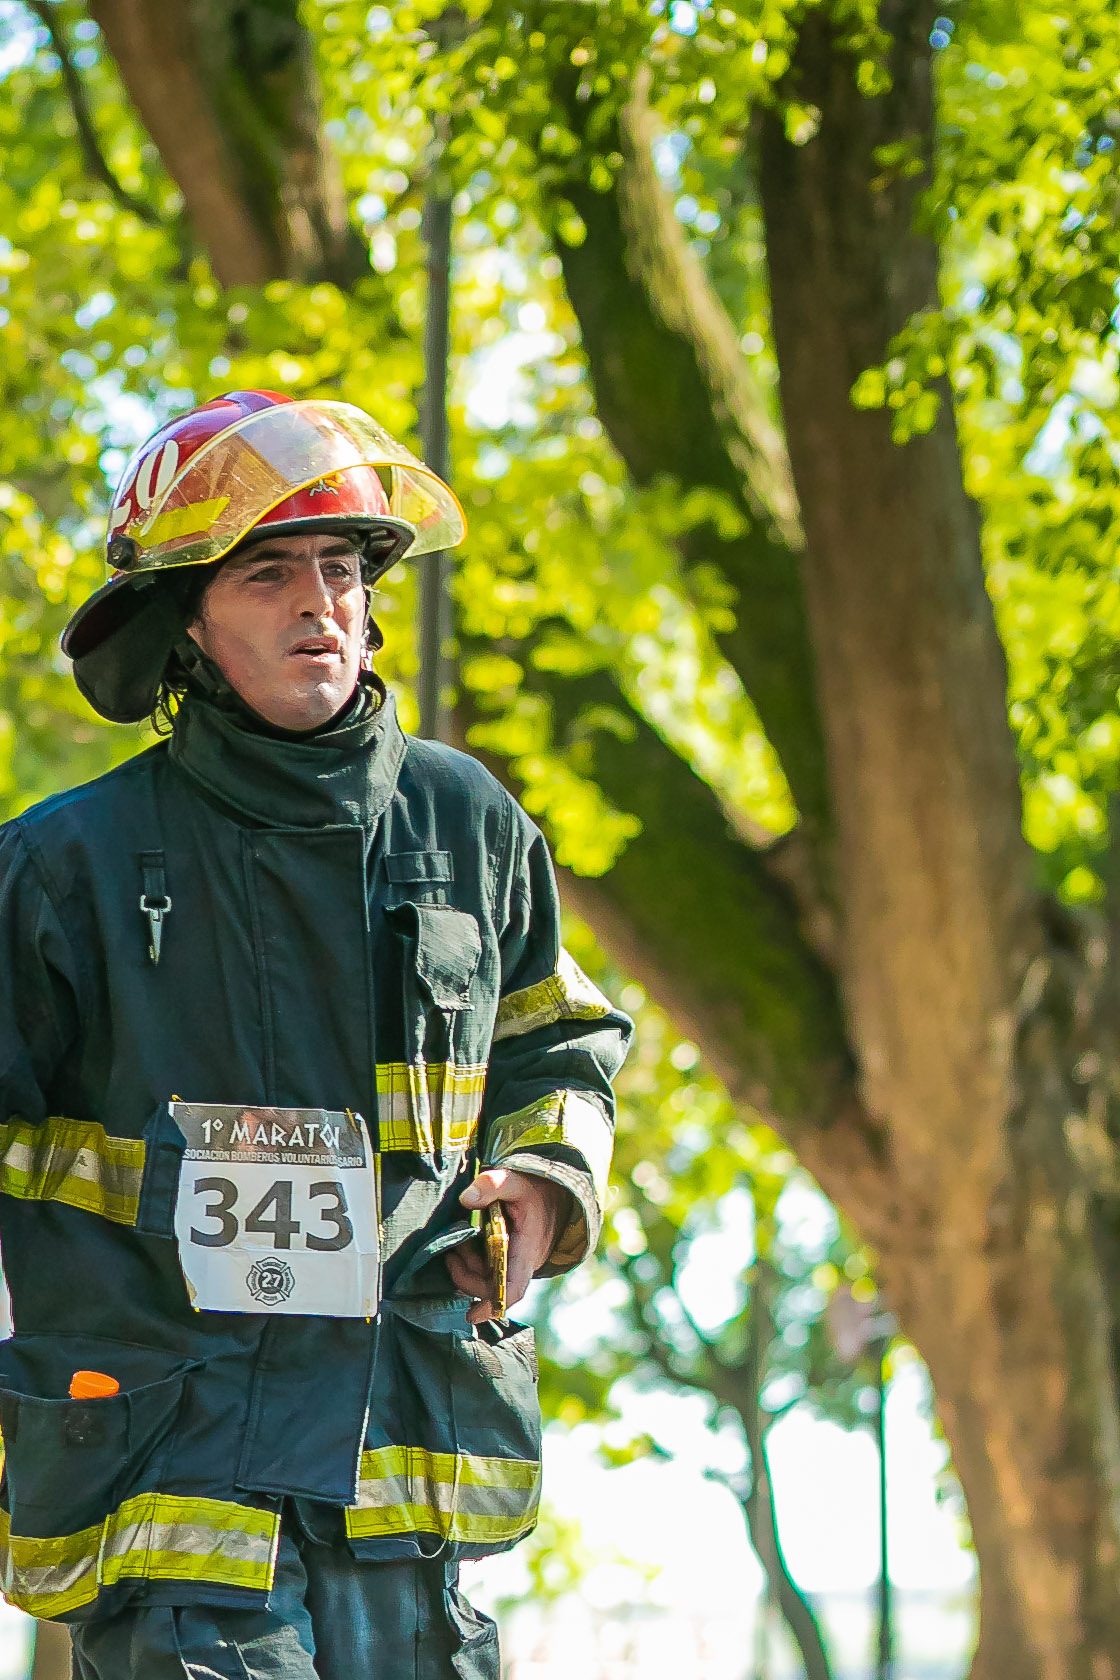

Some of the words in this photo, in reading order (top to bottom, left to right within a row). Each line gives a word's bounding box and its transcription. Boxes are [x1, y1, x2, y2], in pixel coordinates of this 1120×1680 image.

[183, 1148, 230, 1161] SOCIACION
[231, 1151, 280, 1163] BOMBEROS
[190, 1177, 354, 1252] 343
[261, 1271, 282, 1288] 27
